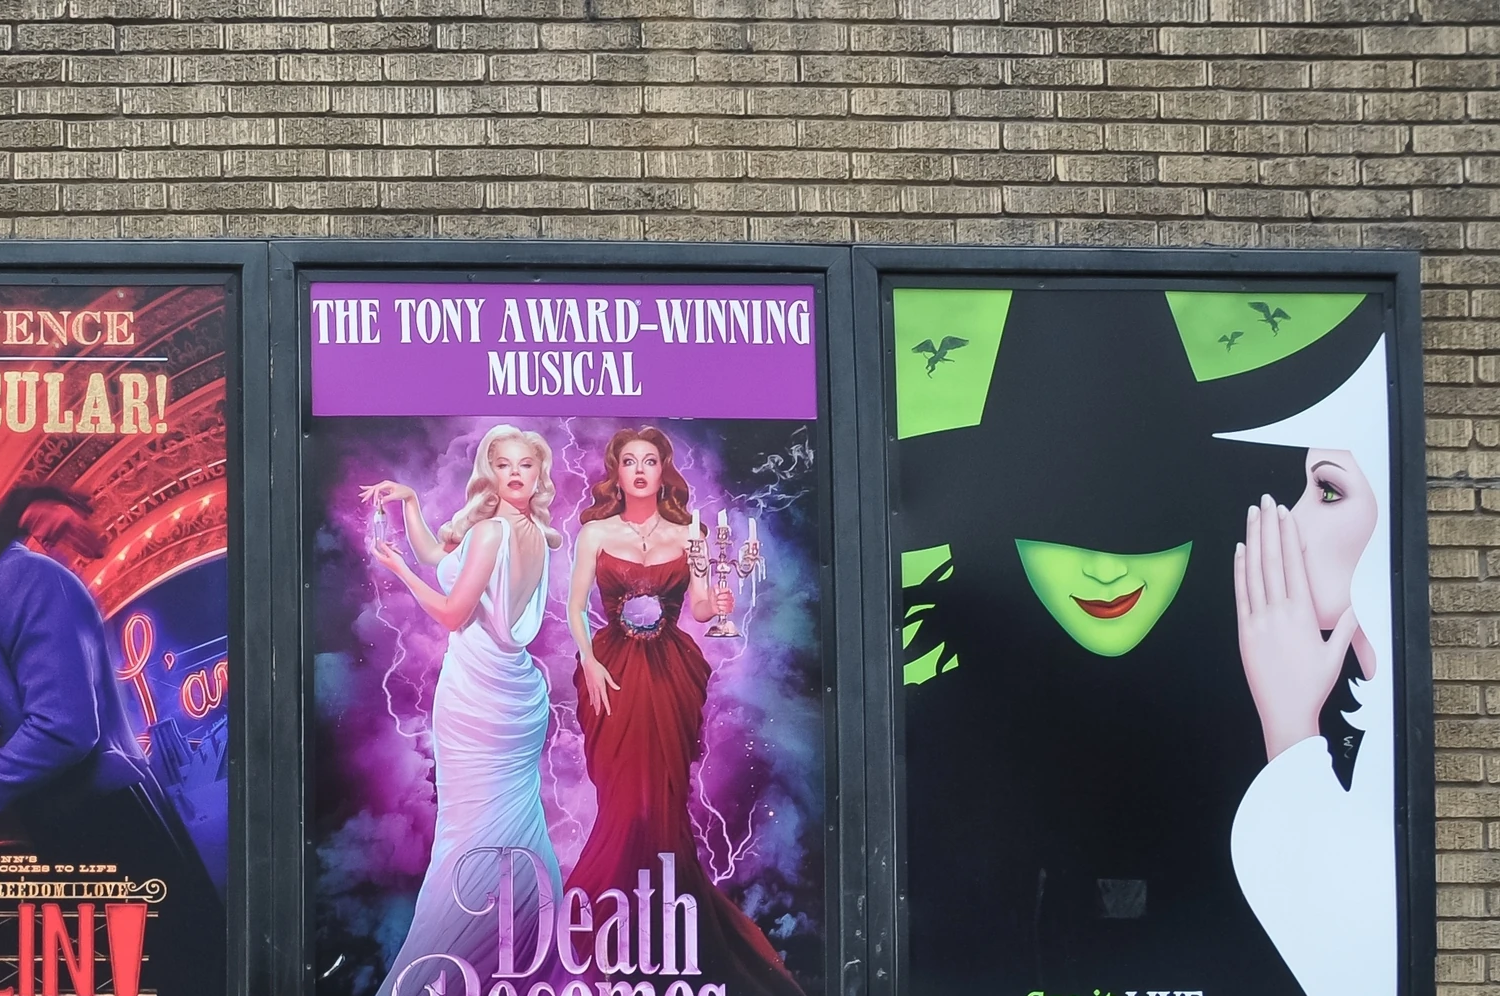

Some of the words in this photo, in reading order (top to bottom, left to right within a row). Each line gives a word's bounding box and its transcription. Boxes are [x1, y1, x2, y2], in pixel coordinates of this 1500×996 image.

[312, 299, 380, 344] THE
[395, 299, 486, 343] TONY
[487, 351, 642, 396] MUSICAL
[0, 865, 50, 873] COMES
[55, 865, 74, 873] TO
[79, 865, 117, 873] LIFE
[83, 883, 128, 898] LOVE
[452, 847, 702, 978] Death
